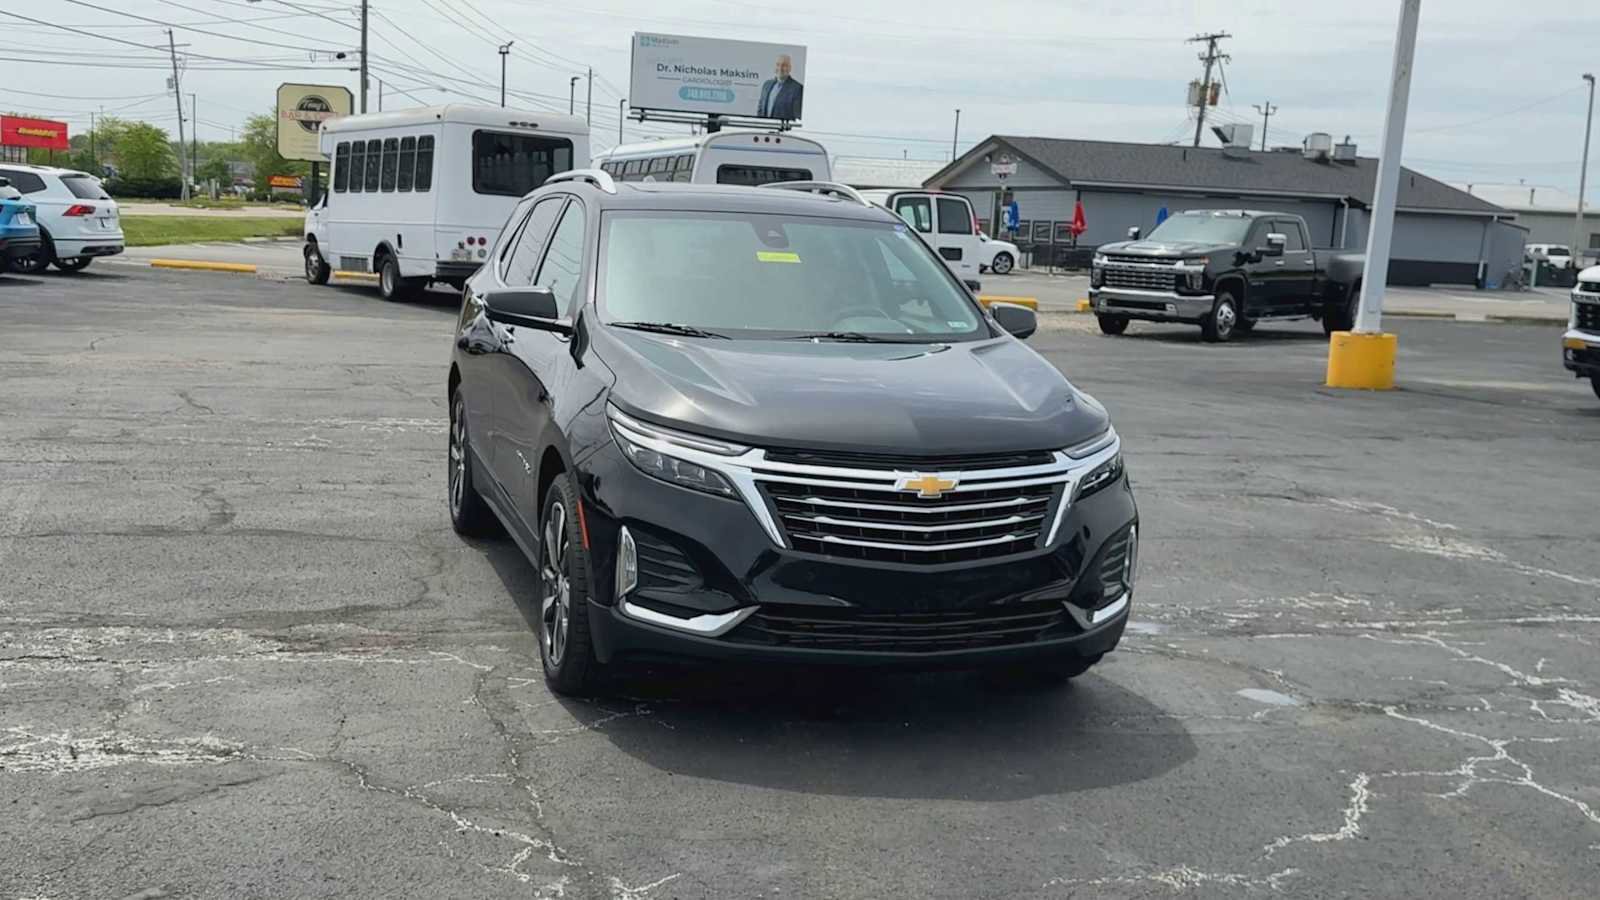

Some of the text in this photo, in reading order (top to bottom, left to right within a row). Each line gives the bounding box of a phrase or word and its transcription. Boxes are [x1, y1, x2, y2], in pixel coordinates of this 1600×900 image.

[656, 63, 760, 80] Dr. Nicholas Maksim
